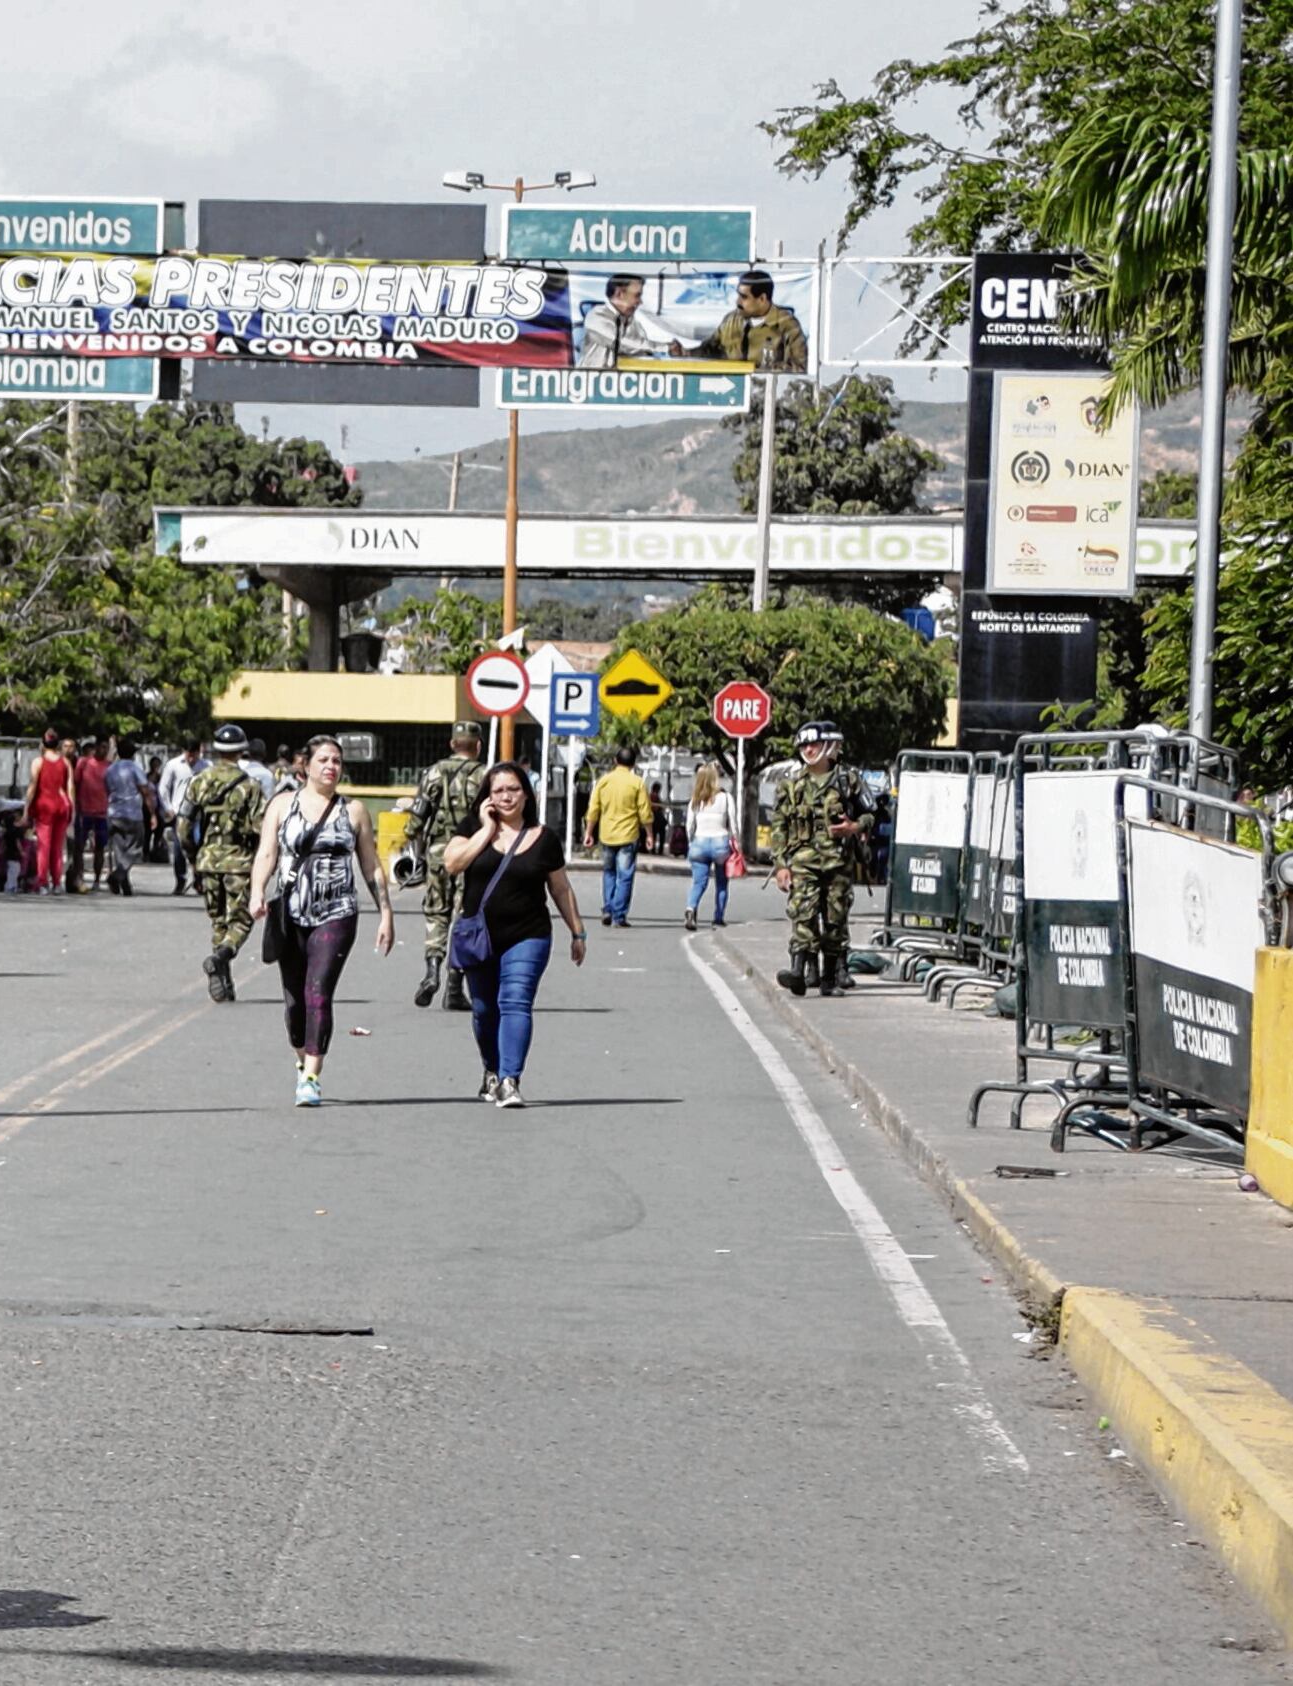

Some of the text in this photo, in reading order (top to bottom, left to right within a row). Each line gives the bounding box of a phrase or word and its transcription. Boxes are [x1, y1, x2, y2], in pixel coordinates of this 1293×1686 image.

[569, 217, 688, 254] Aduana
[149, 258, 548, 318] PRESIDENTES
[112, 310, 217, 333] SANTOS
[232, 313, 249, 334] Y
[265, 315, 380, 339] NICOLAS
[396, 318, 516, 341] MADURO
[986, 322, 1026, 334] CENTRO
[217, 338, 239, 355] A
[248, 339, 419, 359] COLOMBIA
[979, 334, 1030, 346] ATENCIÓN
[1032, 336, 1046, 346] EN
[1086, 505, 1109, 523] ica
[351, 527, 420, 549] DIAN
[575, 525, 950, 562] Bienvenidos
[979, 622, 1082, 634] NORTE DE SANTANDER
[564, 681, 583, 711] P
[723, 698, 762, 720] PARE
[1058, 957, 1069, 984] DE
[1194, 993, 1239, 1035] NACIONAL
[1172, 1020, 1233, 1067] DE COLOMBIA
